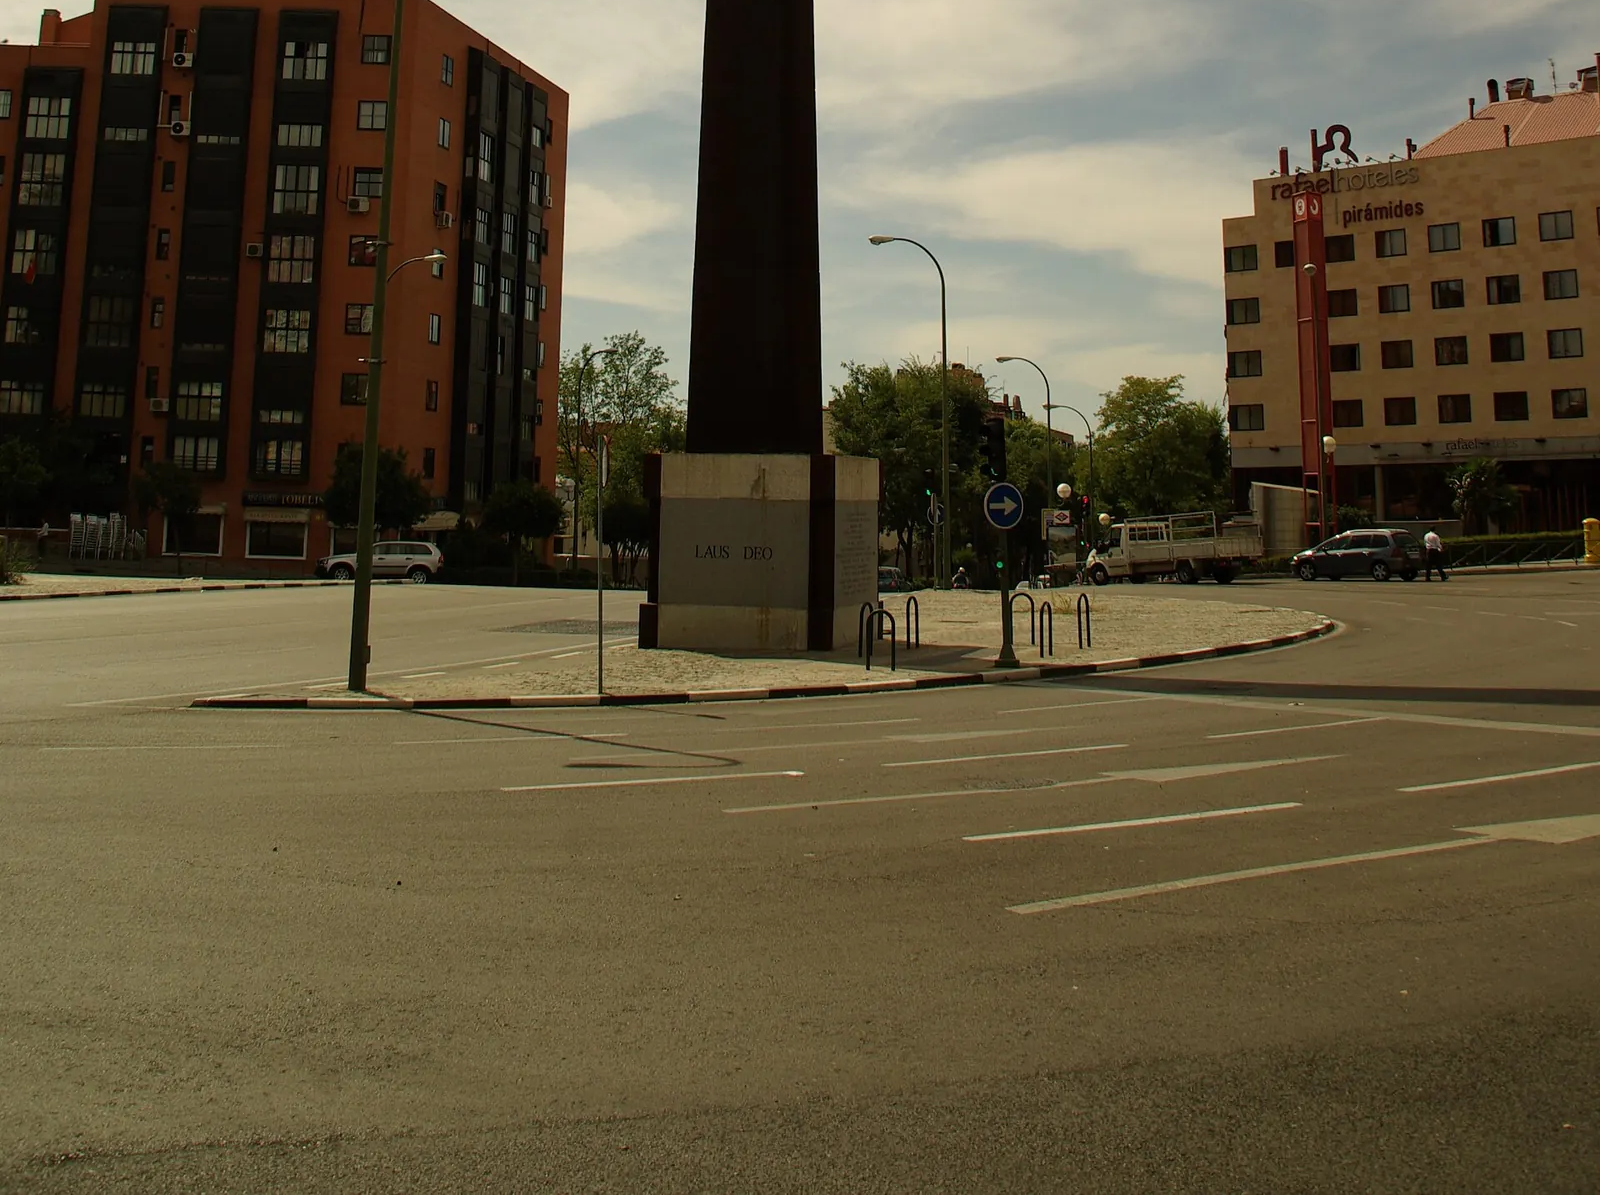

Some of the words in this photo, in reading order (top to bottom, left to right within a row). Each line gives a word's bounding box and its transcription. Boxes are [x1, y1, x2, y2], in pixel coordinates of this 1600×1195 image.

[1343, 200, 1424, 228] pirámides
[695, 545, 730, 559] LAUS
[743, 546, 773, 561] DEO
